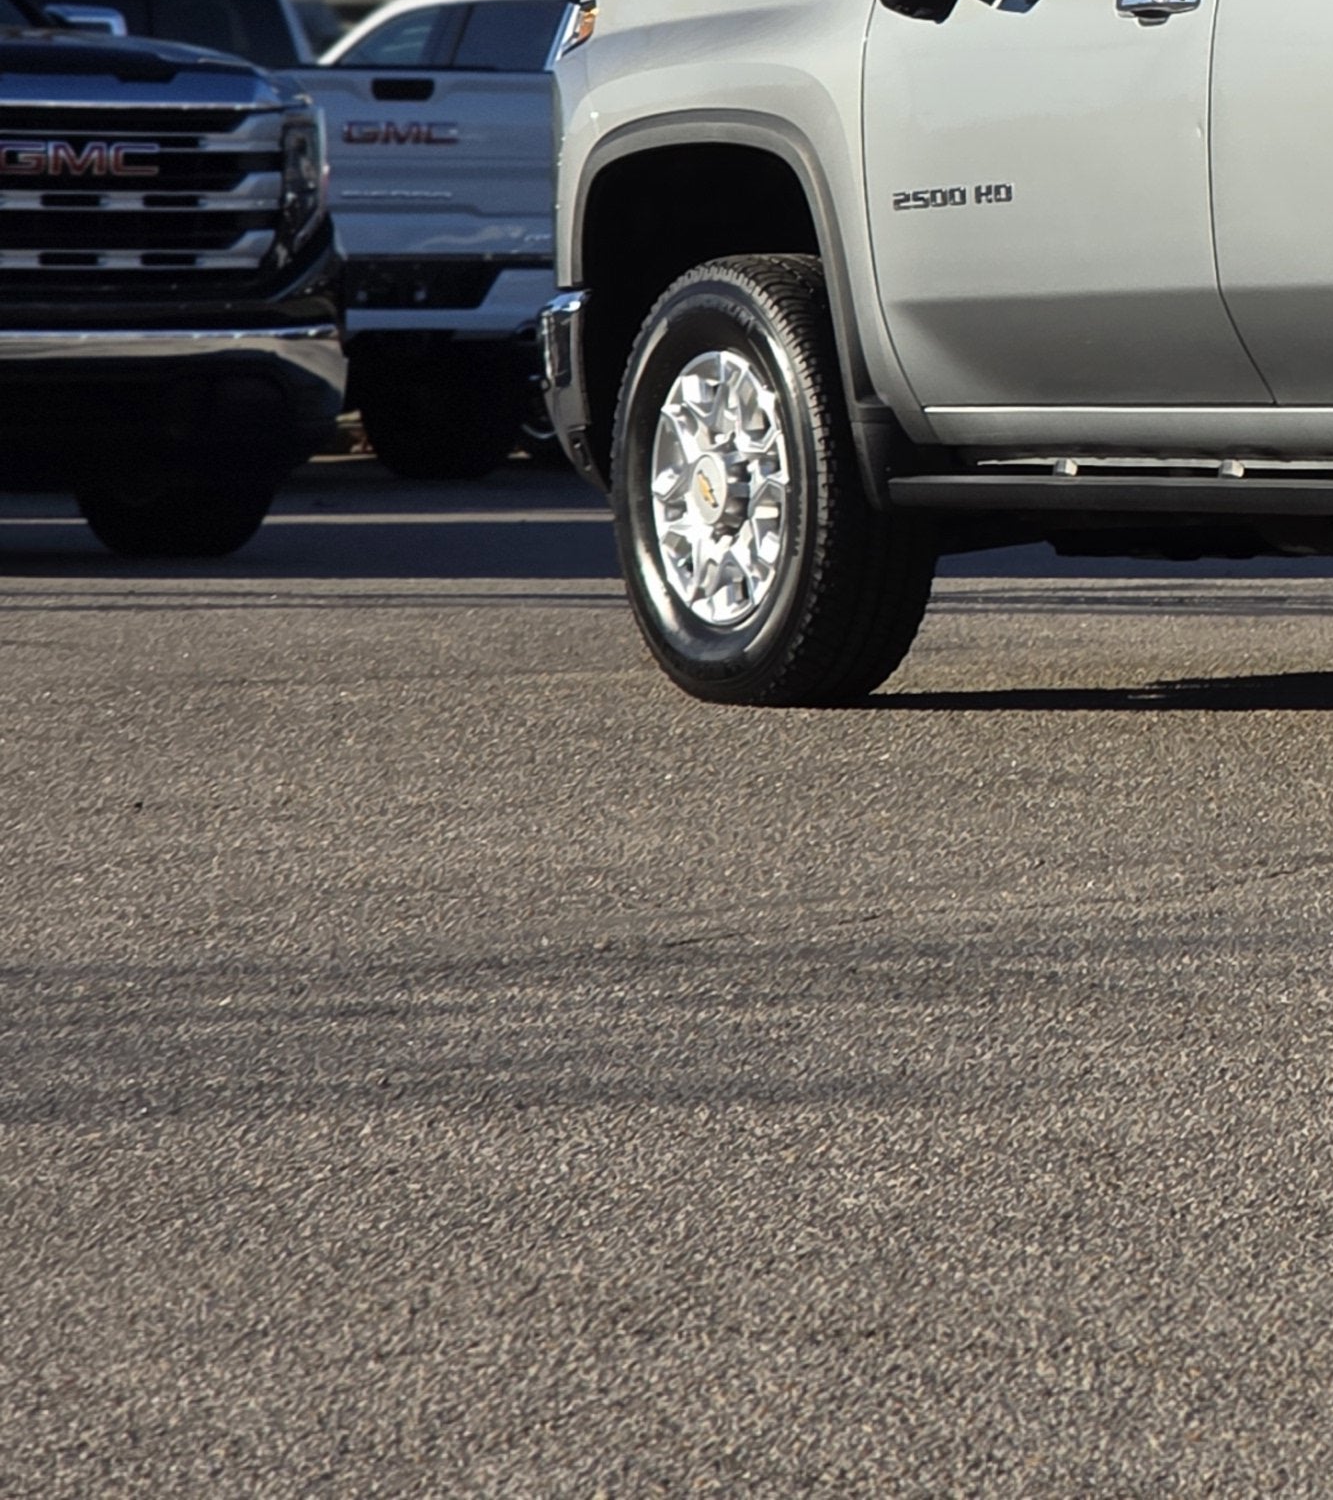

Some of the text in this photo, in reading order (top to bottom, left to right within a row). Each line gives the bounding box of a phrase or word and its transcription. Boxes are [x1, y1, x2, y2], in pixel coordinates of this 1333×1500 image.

[342, 120, 459, 145] GMC
[0, 140, 160, 176] GMC
[892, 183, 1013, 211] 2500 HD
